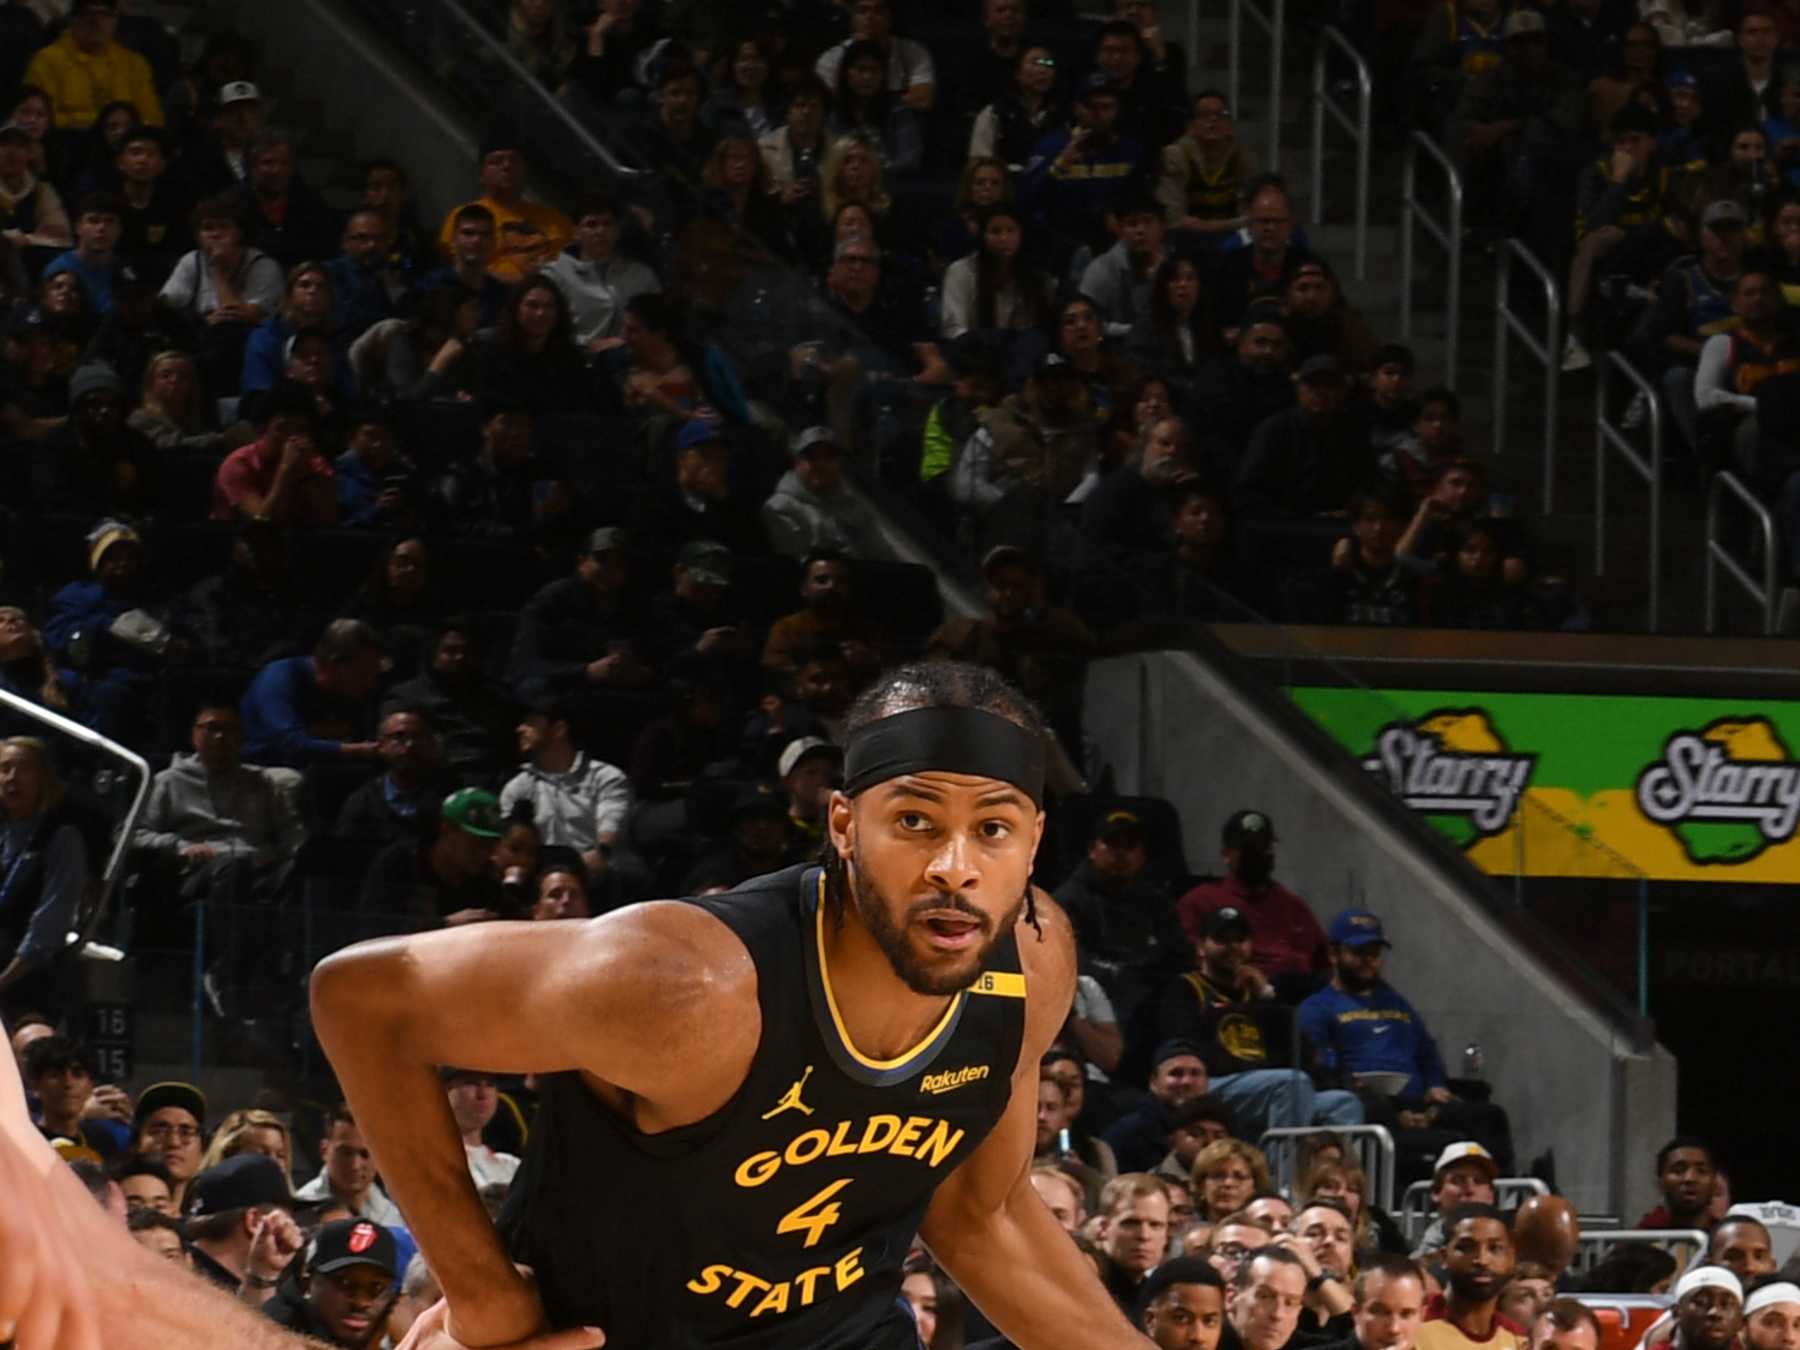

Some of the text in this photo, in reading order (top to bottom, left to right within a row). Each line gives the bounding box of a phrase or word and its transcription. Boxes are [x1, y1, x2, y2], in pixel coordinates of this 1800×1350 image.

[1364, 729, 1531, 831] Starry
[1639, 735, 1800, 839] Starry
[97, 1049, 127, 1078] 15
[919, 1064, 990, 1095] Rakuten
[734, 1114, 965, 1187] GOLDEN
[776, 1178, 855, 1248] 4
[686, 1247, 865, 1317] STATE
